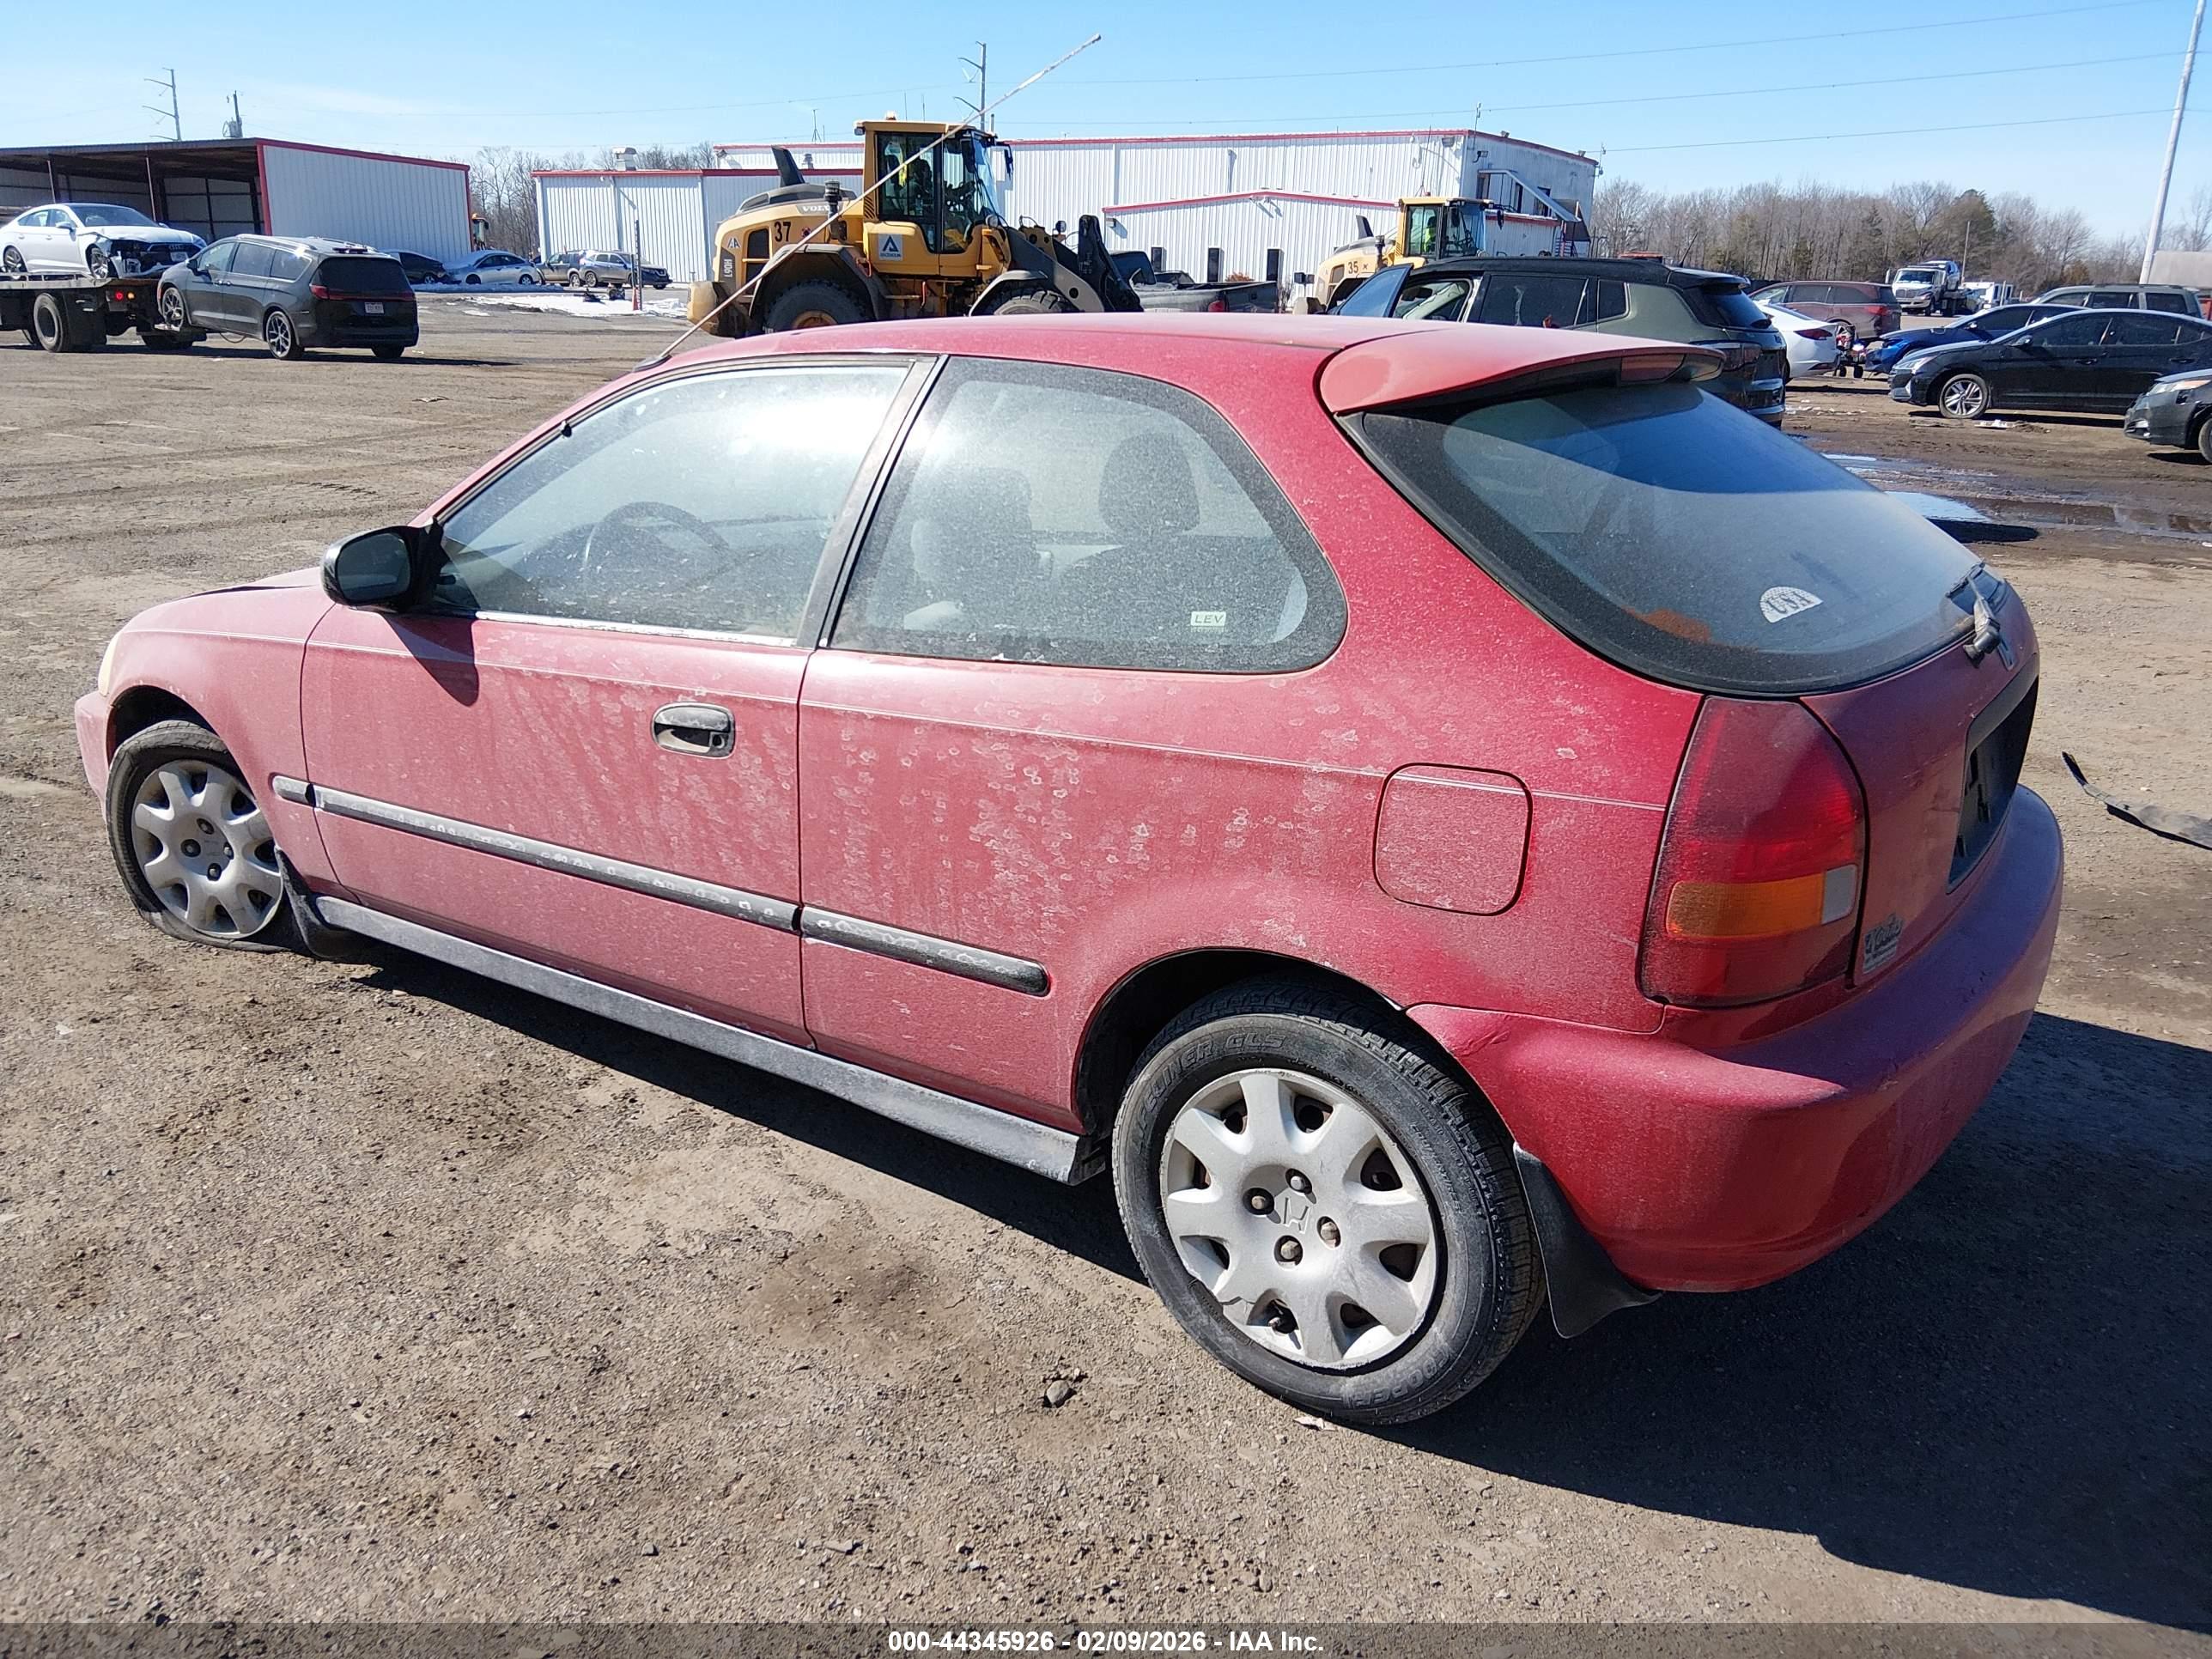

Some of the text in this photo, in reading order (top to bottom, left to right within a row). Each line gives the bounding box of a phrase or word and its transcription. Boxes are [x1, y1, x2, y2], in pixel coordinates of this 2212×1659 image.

[774, 221, 791, 242] 37
[723, 258, 733, 278] L90H
[1347, 260, 1358, 274] 35
[1194, 614, 1224, 623] LEV
[1224, 1032, 1286, 1049] GLS
